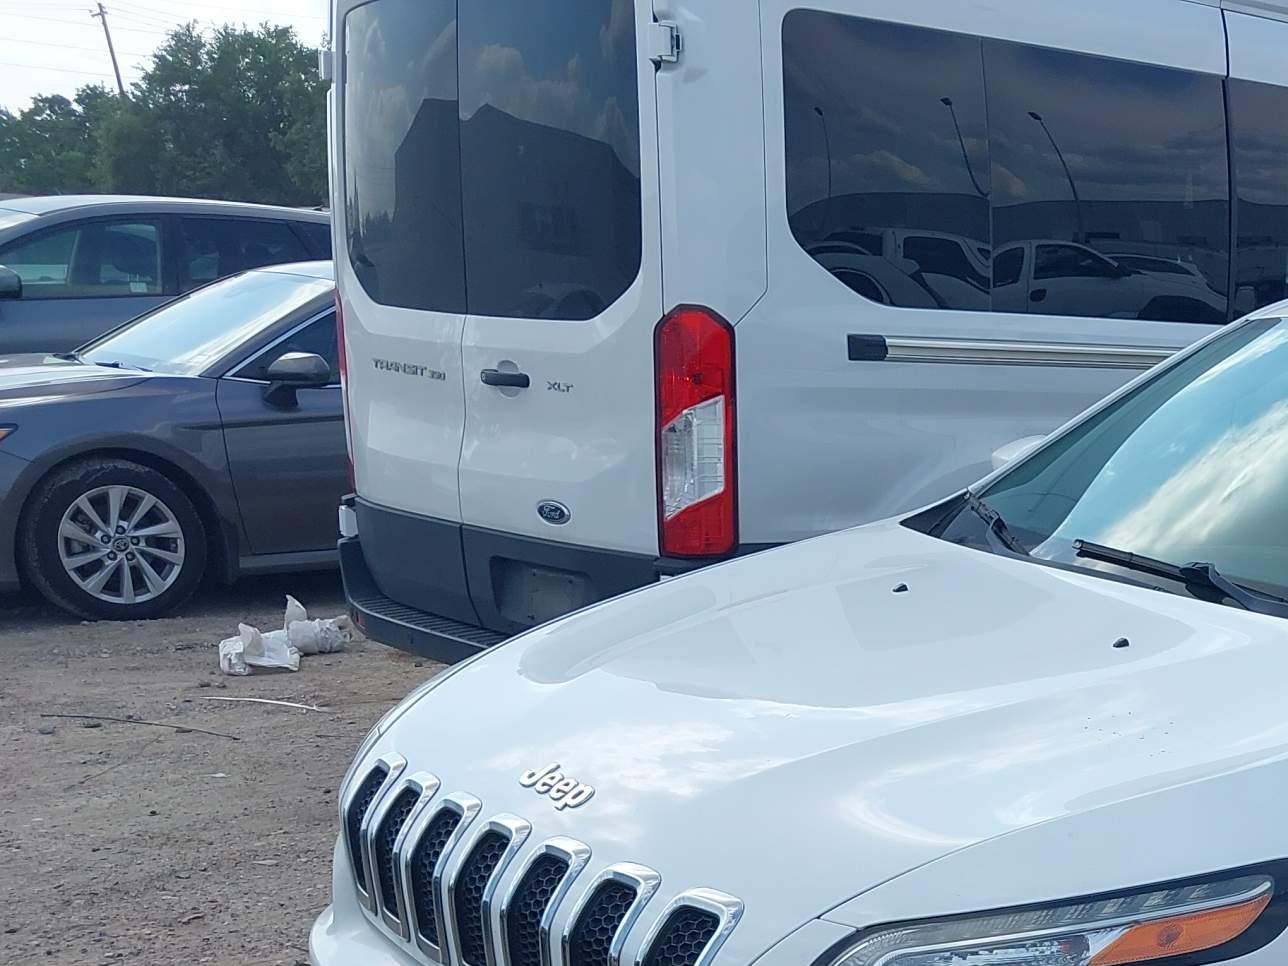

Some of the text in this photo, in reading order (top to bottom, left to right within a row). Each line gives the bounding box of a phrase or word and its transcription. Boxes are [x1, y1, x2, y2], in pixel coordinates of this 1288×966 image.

[372, 358, 428, 377] TRANSIT
[546, 380, 575, 393] XLT
[518, 762, 596, 811] Jeep
